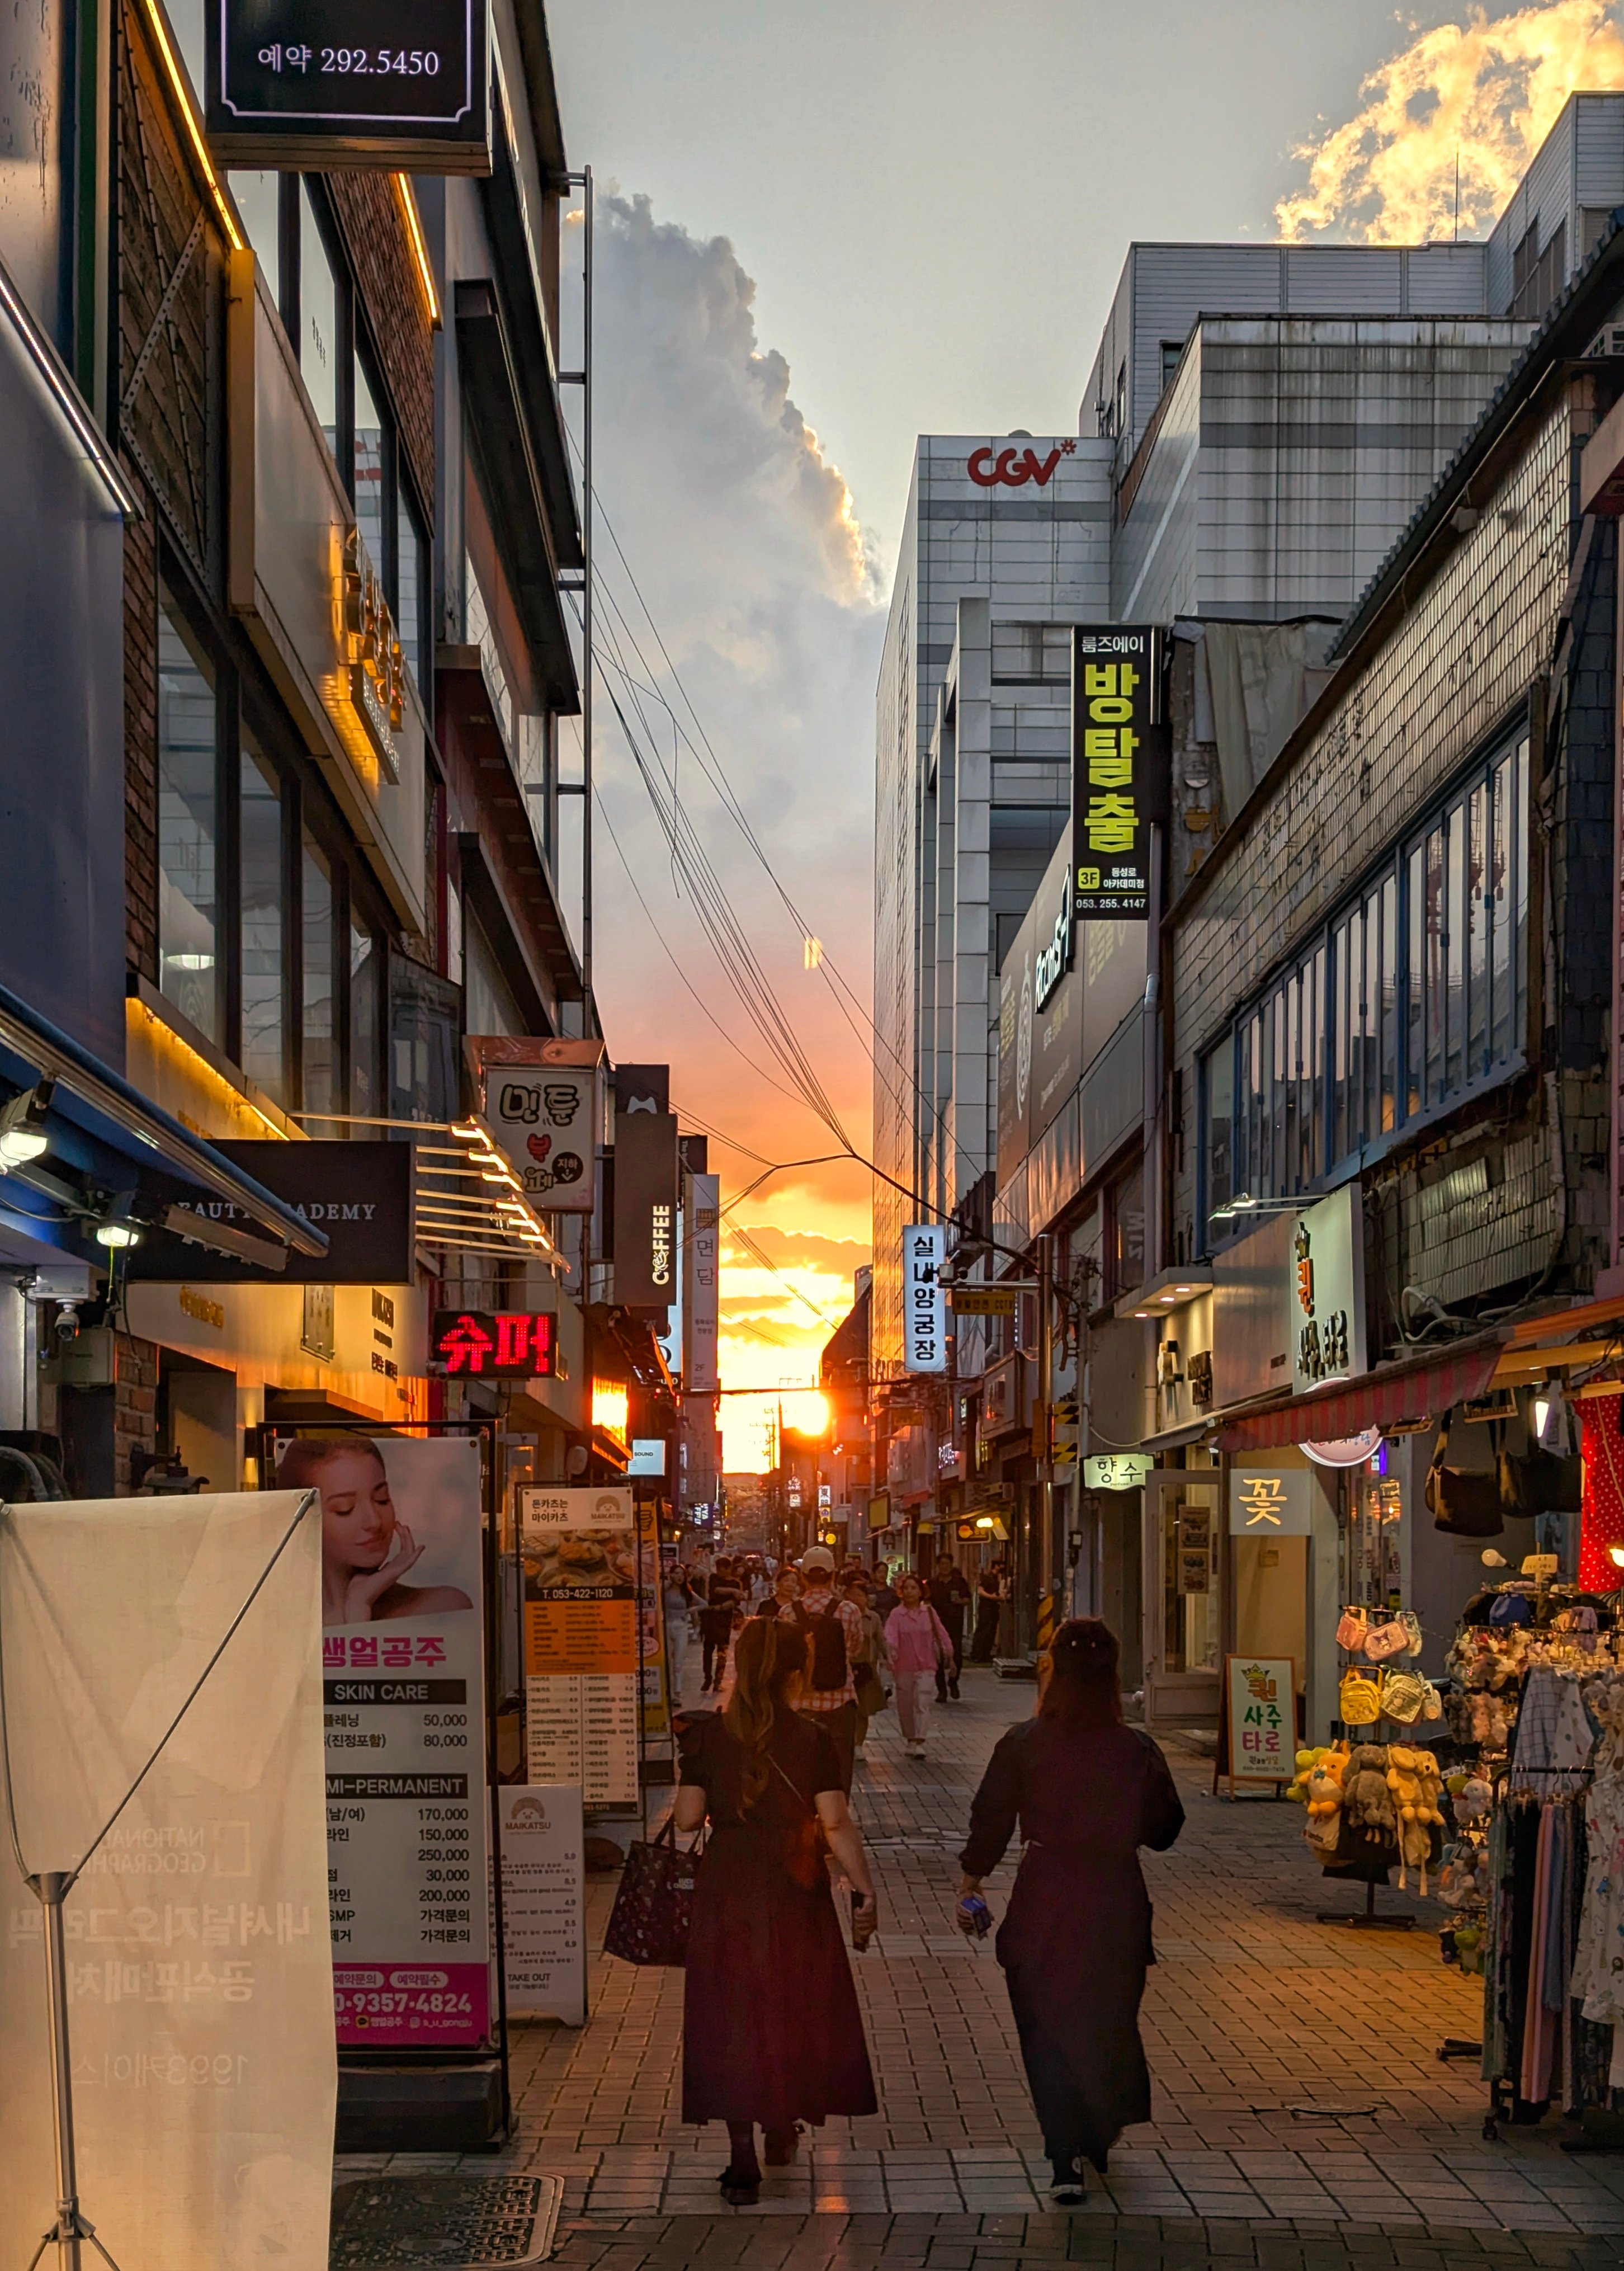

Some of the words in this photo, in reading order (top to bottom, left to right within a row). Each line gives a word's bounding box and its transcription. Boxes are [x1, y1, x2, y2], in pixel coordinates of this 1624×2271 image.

[257, 44, 313, 73] 예약
[320, 48, 440, 75] 292.5450
[967, 446, 1061, 487] CGV
[1081, 636, 1144, 653] 룸즈에이
[1084, 662, 1140, 854] 방탈출
[1080, 871, 1098, 885] 3F
[1111, 867, 1137, 878] 동성로
[1103, 878, 1145, 891] 아카데미점
[913, 1236, 936, 1361] 실내양궁장
[439, 1315, 549, 1373] 슈퍼
[1097, 1457, 1142, 1483] 향수
[531, 1499, 568, 1509] 돈카츠는
[1238, 1477, 1288, 1526] 꽃
[531, 1512, 569, 1523] 마이카츠
[553, 1588, 613, 1599] 053-422-1120
[334, 1684, 375, 1700] SKIN
[380, 1684, 429, 1700] CARE
[1248, 1679, 1278, 1702] 퀸
[423, 1714, 468, 1727] 50,000
[1244, 1704, 1283, 1730] 사주
[324, 1733, 386, 1749] (진정포함)
[423, 1735, 468, 1748] 80,000
[1242, 1730, 1281, 1752] 타로
[418, 1808, 469, 1822] 170,000
[505, 1821, 551, 1830] MAIKATSU
[418, 1829, 469, 1841] 150,000
[417, 1849, 470, 1862] 250,000
[426, 1869, 470, 1882] 30,000
[419, 1890, 470, 1902] 200,000
[420, 1909, 470, 1923] 가격문의
[420, 1929, 470, 1943] 가격문의
[333, 1973, 377, 1985] 예약문의
[396, 1973, 441, 1985] 예약필수
[507, 1973, 530, 1982] TAKE
[532, 1973, 551, 1981] OUT
